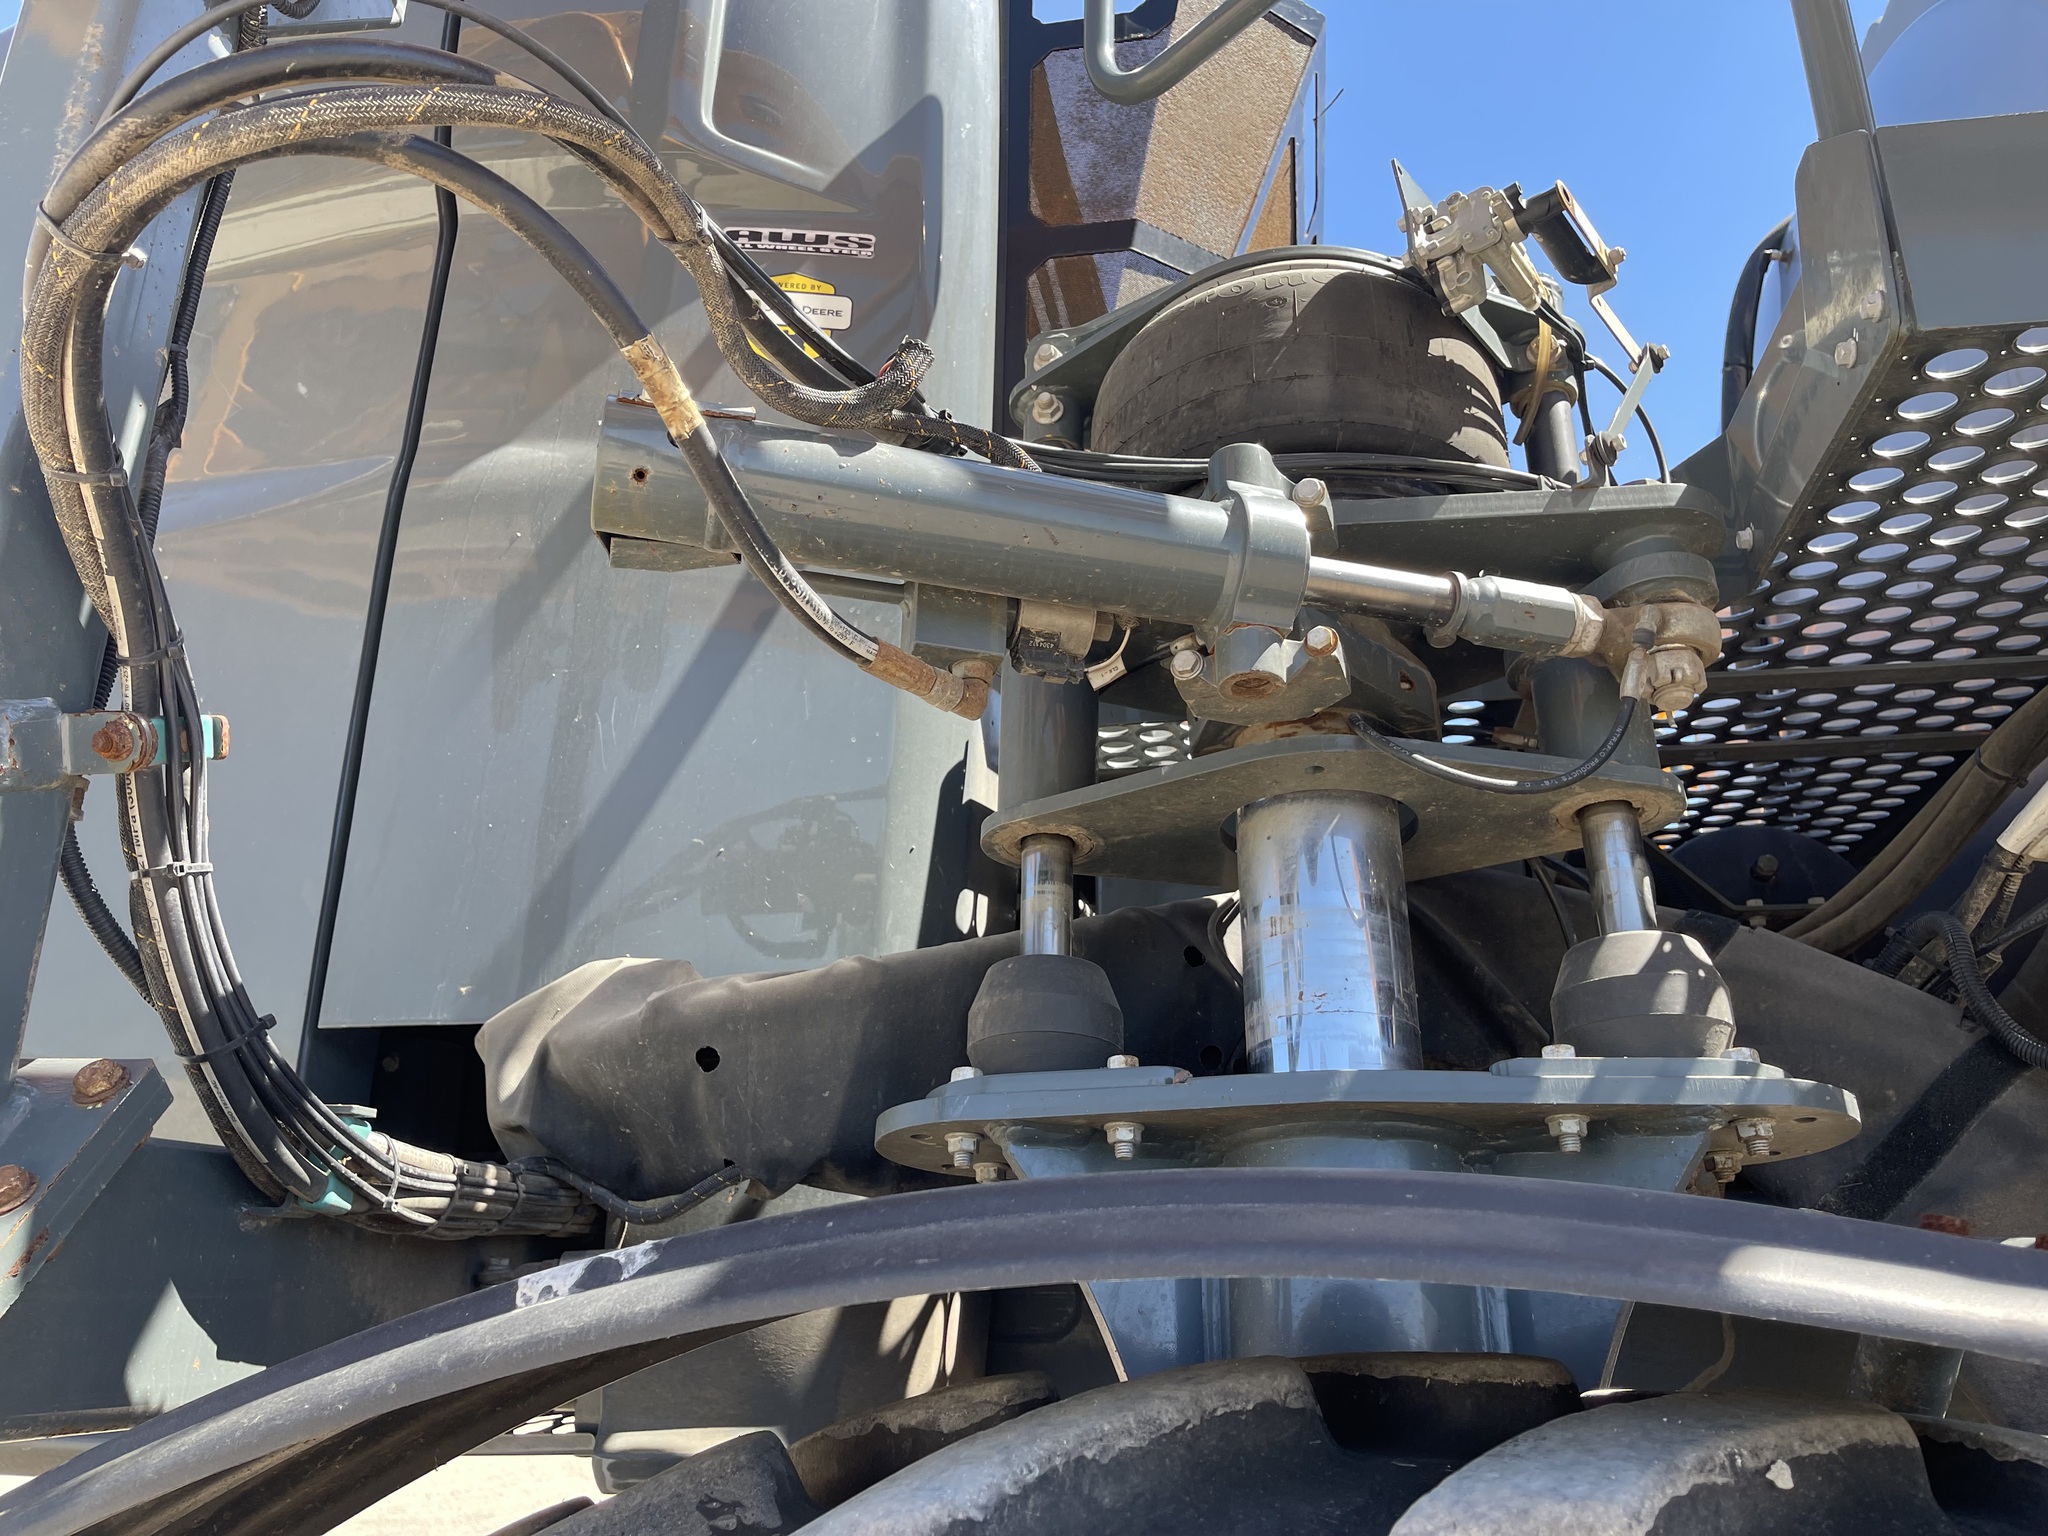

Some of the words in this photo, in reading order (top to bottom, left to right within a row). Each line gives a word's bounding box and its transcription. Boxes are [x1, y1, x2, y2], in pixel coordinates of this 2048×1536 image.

[725, 230, 874, 249] AWS
[819, 247, 873, 256] STEER
[775, 281, 807, 290] WERED
[802, 306, 843, 318] DEERE
[1599, 724, 1625, 758] INTRAFLO
[1561, 757, 1600, 783] PRODUCTS
